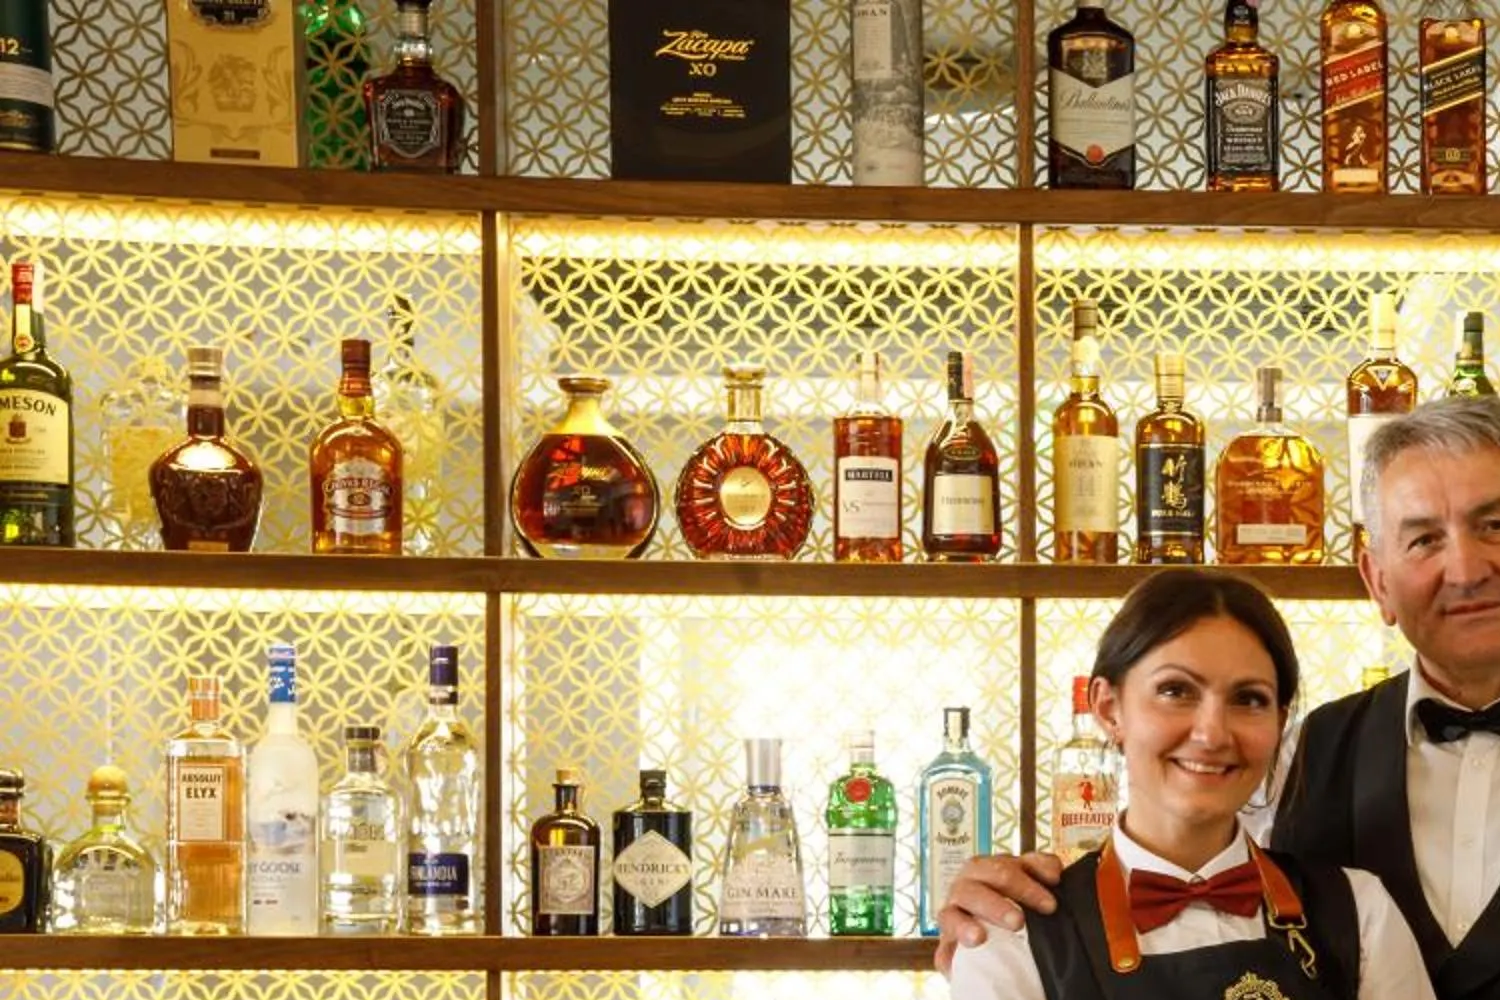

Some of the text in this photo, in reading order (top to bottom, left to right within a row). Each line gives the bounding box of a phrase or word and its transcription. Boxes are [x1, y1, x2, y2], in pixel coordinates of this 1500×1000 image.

[655, 29, 755, 61] Zacapa
[688, 62, 717, 77] XO
[1324, 60, 1384, 88] RED LABEL
[182, 774, 221, 783] ABSOLUT
[186, 787, 217, 799] ELYX
[1061, 812, 1114, 827] BEEFEATER
